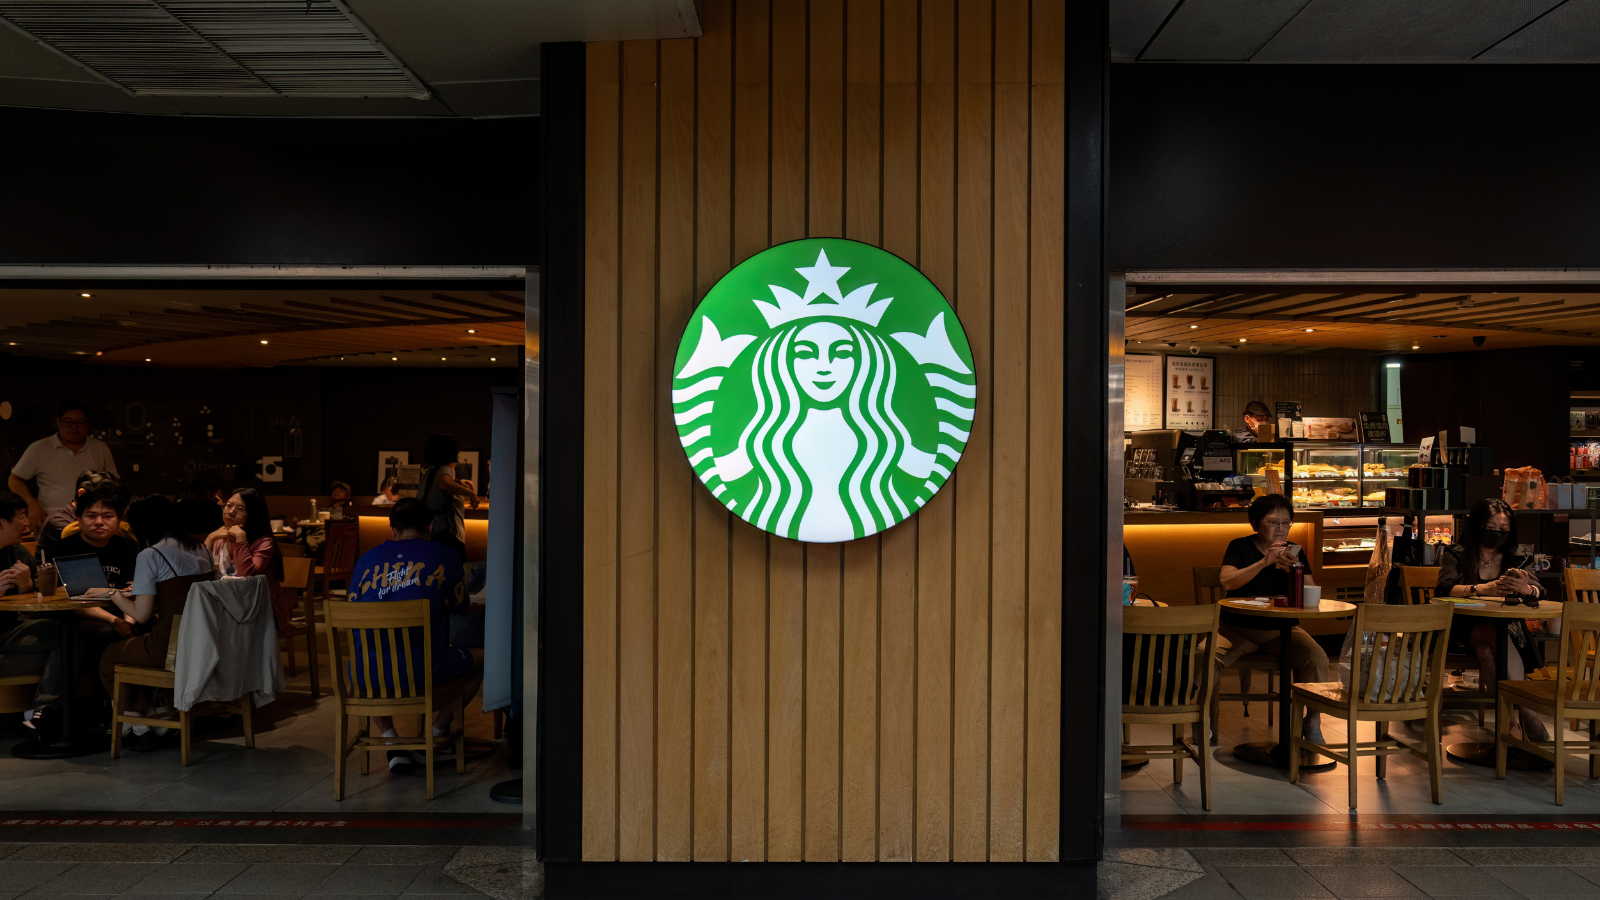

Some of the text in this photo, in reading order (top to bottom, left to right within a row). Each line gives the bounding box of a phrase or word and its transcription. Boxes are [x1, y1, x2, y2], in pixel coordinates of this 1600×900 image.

[387, 566, 412, 583] Fight
[378, 577, 419, 599] for dream
